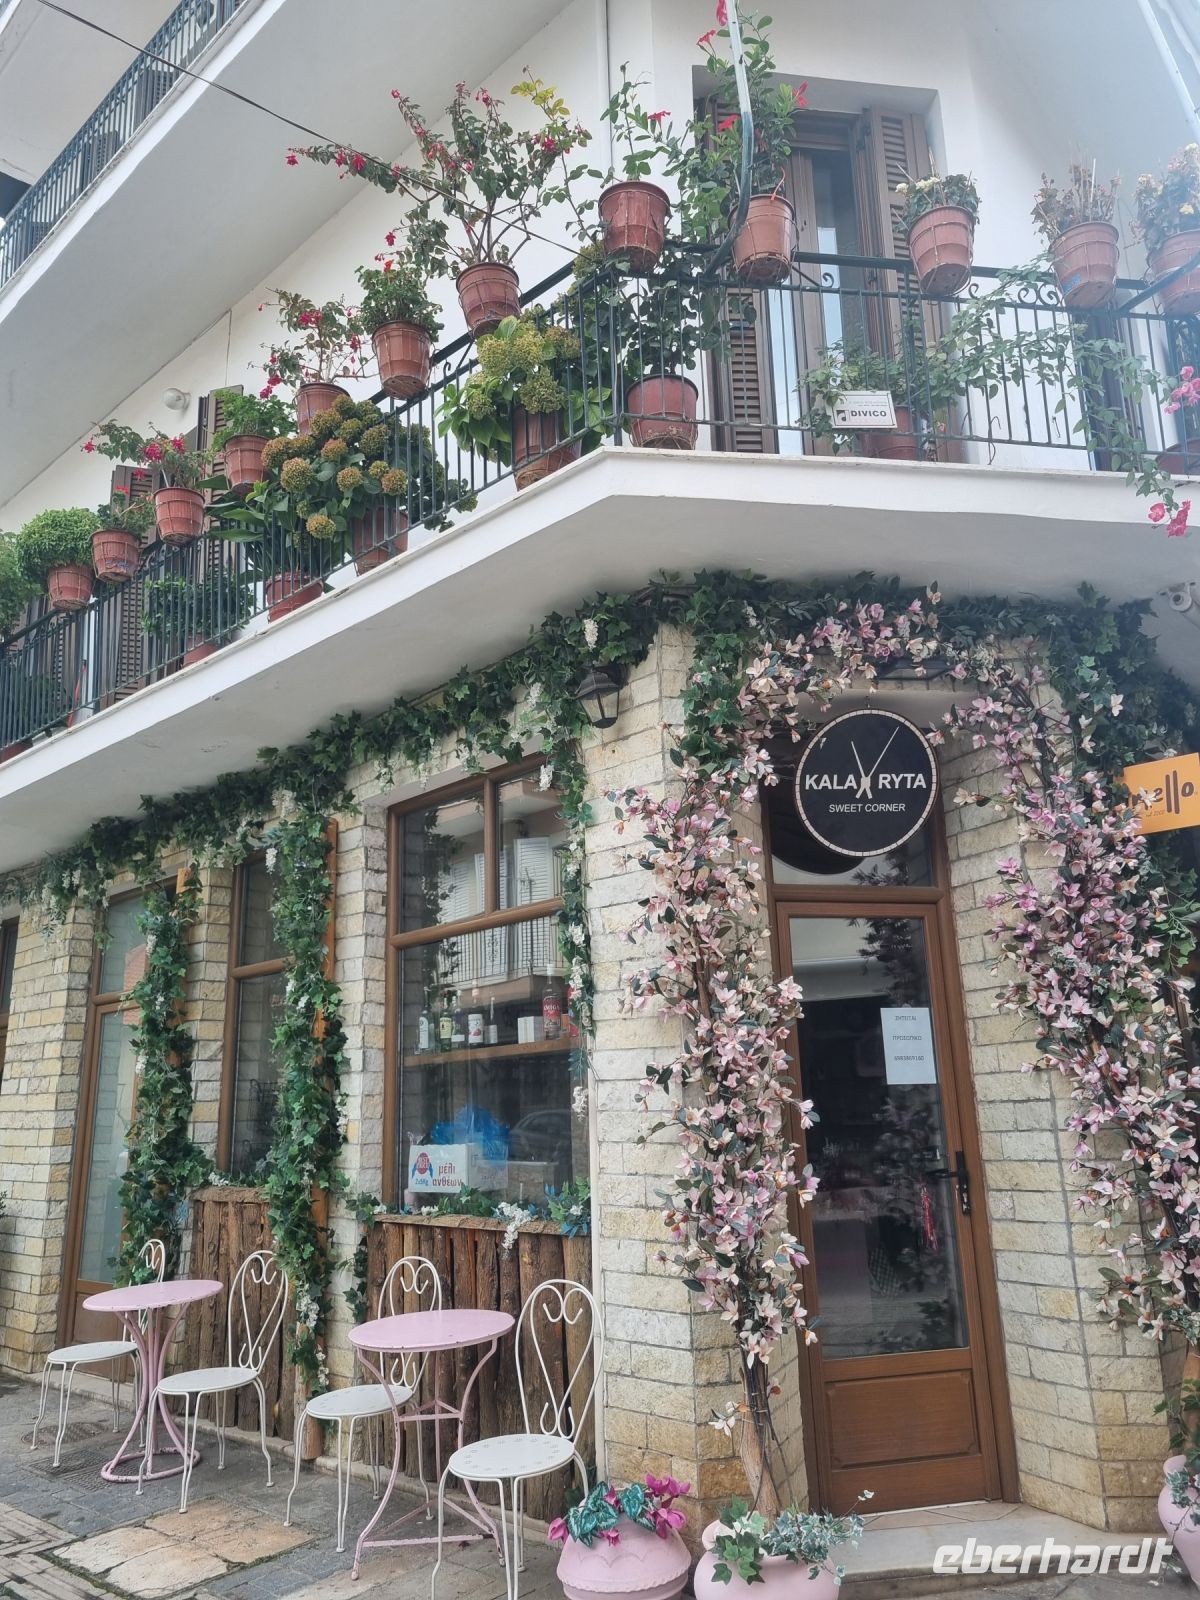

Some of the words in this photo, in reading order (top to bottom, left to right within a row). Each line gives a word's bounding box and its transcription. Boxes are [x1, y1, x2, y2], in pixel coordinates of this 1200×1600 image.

[828, 803, 863, 813] SWEET
[865, 803, 906, 812] CORNER
[438, 1162, 456, 1176] μέλι
[432, 1176, 462, 1187] ανθέων
